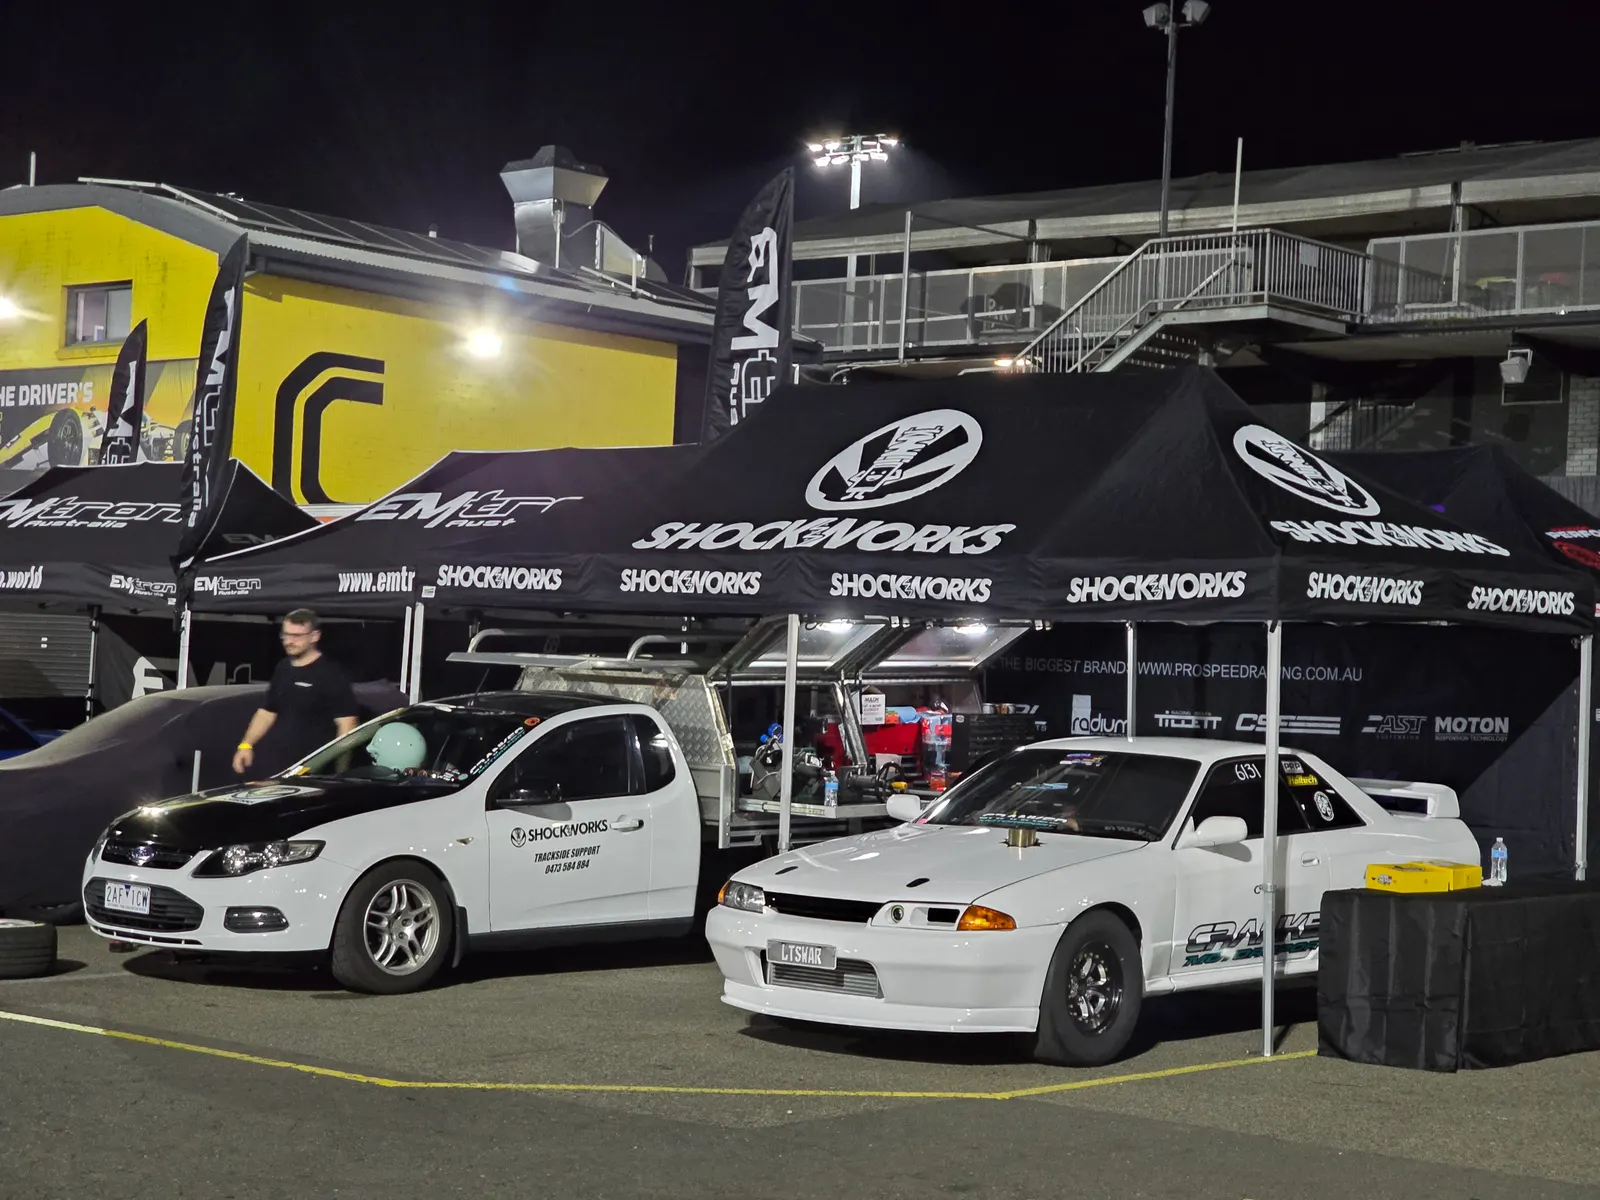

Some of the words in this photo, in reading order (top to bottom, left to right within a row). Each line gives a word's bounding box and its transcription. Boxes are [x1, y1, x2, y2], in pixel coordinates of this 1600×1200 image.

[19, 381, 94, 406] DRIVER'S
[0, 496, 183, 528] Mtron
[24, 519, 128, 529] Australia
[632, 517, 1017, 555] SHOCKWORKS
[1269, 520, 1511, 557] SHOCKWORKS
[109, 574, 177, 594] EMtron
[194, 576, 261, 596] EMtron
[338, 565, 416, 593] www.emtr
[437, 564, 563, 590] SHOCKWORKS
[620, 569, 762, 596] SHOCKWORKS
[830, 572, 992, 603] SHOCKWORKS
[1066, 571, 1247, 603] SHOCKWORKS
[1306, 571, 1424, 606] SHOCKWORKS
[1467, 586, 1575, 616] SHOCKWORKS
[1025, 657, 1081, 673] BIGGEST
[1083, 660, 1129, 675] BRAND
[1137, 660, 1363, 682] WWW.PROSPEEDRANG.COM.AU
[1072, 712, 1129, 734] radium
[1435, 716, 1509, 734] MOTON
[1235, 763, 1262, 781] 6131
[528, 819, 608, 842] SHOCKWORKS
[534, 848, 570, 863] TRACKSIDE
[570, 845, 601, 859] SUPPORT
[545, 863, 562, 875] 0473
[562, 861, 576, 872] 584
[576, 859, 590, 870] 884
[781, 943, 822, 965] LTSWAR
